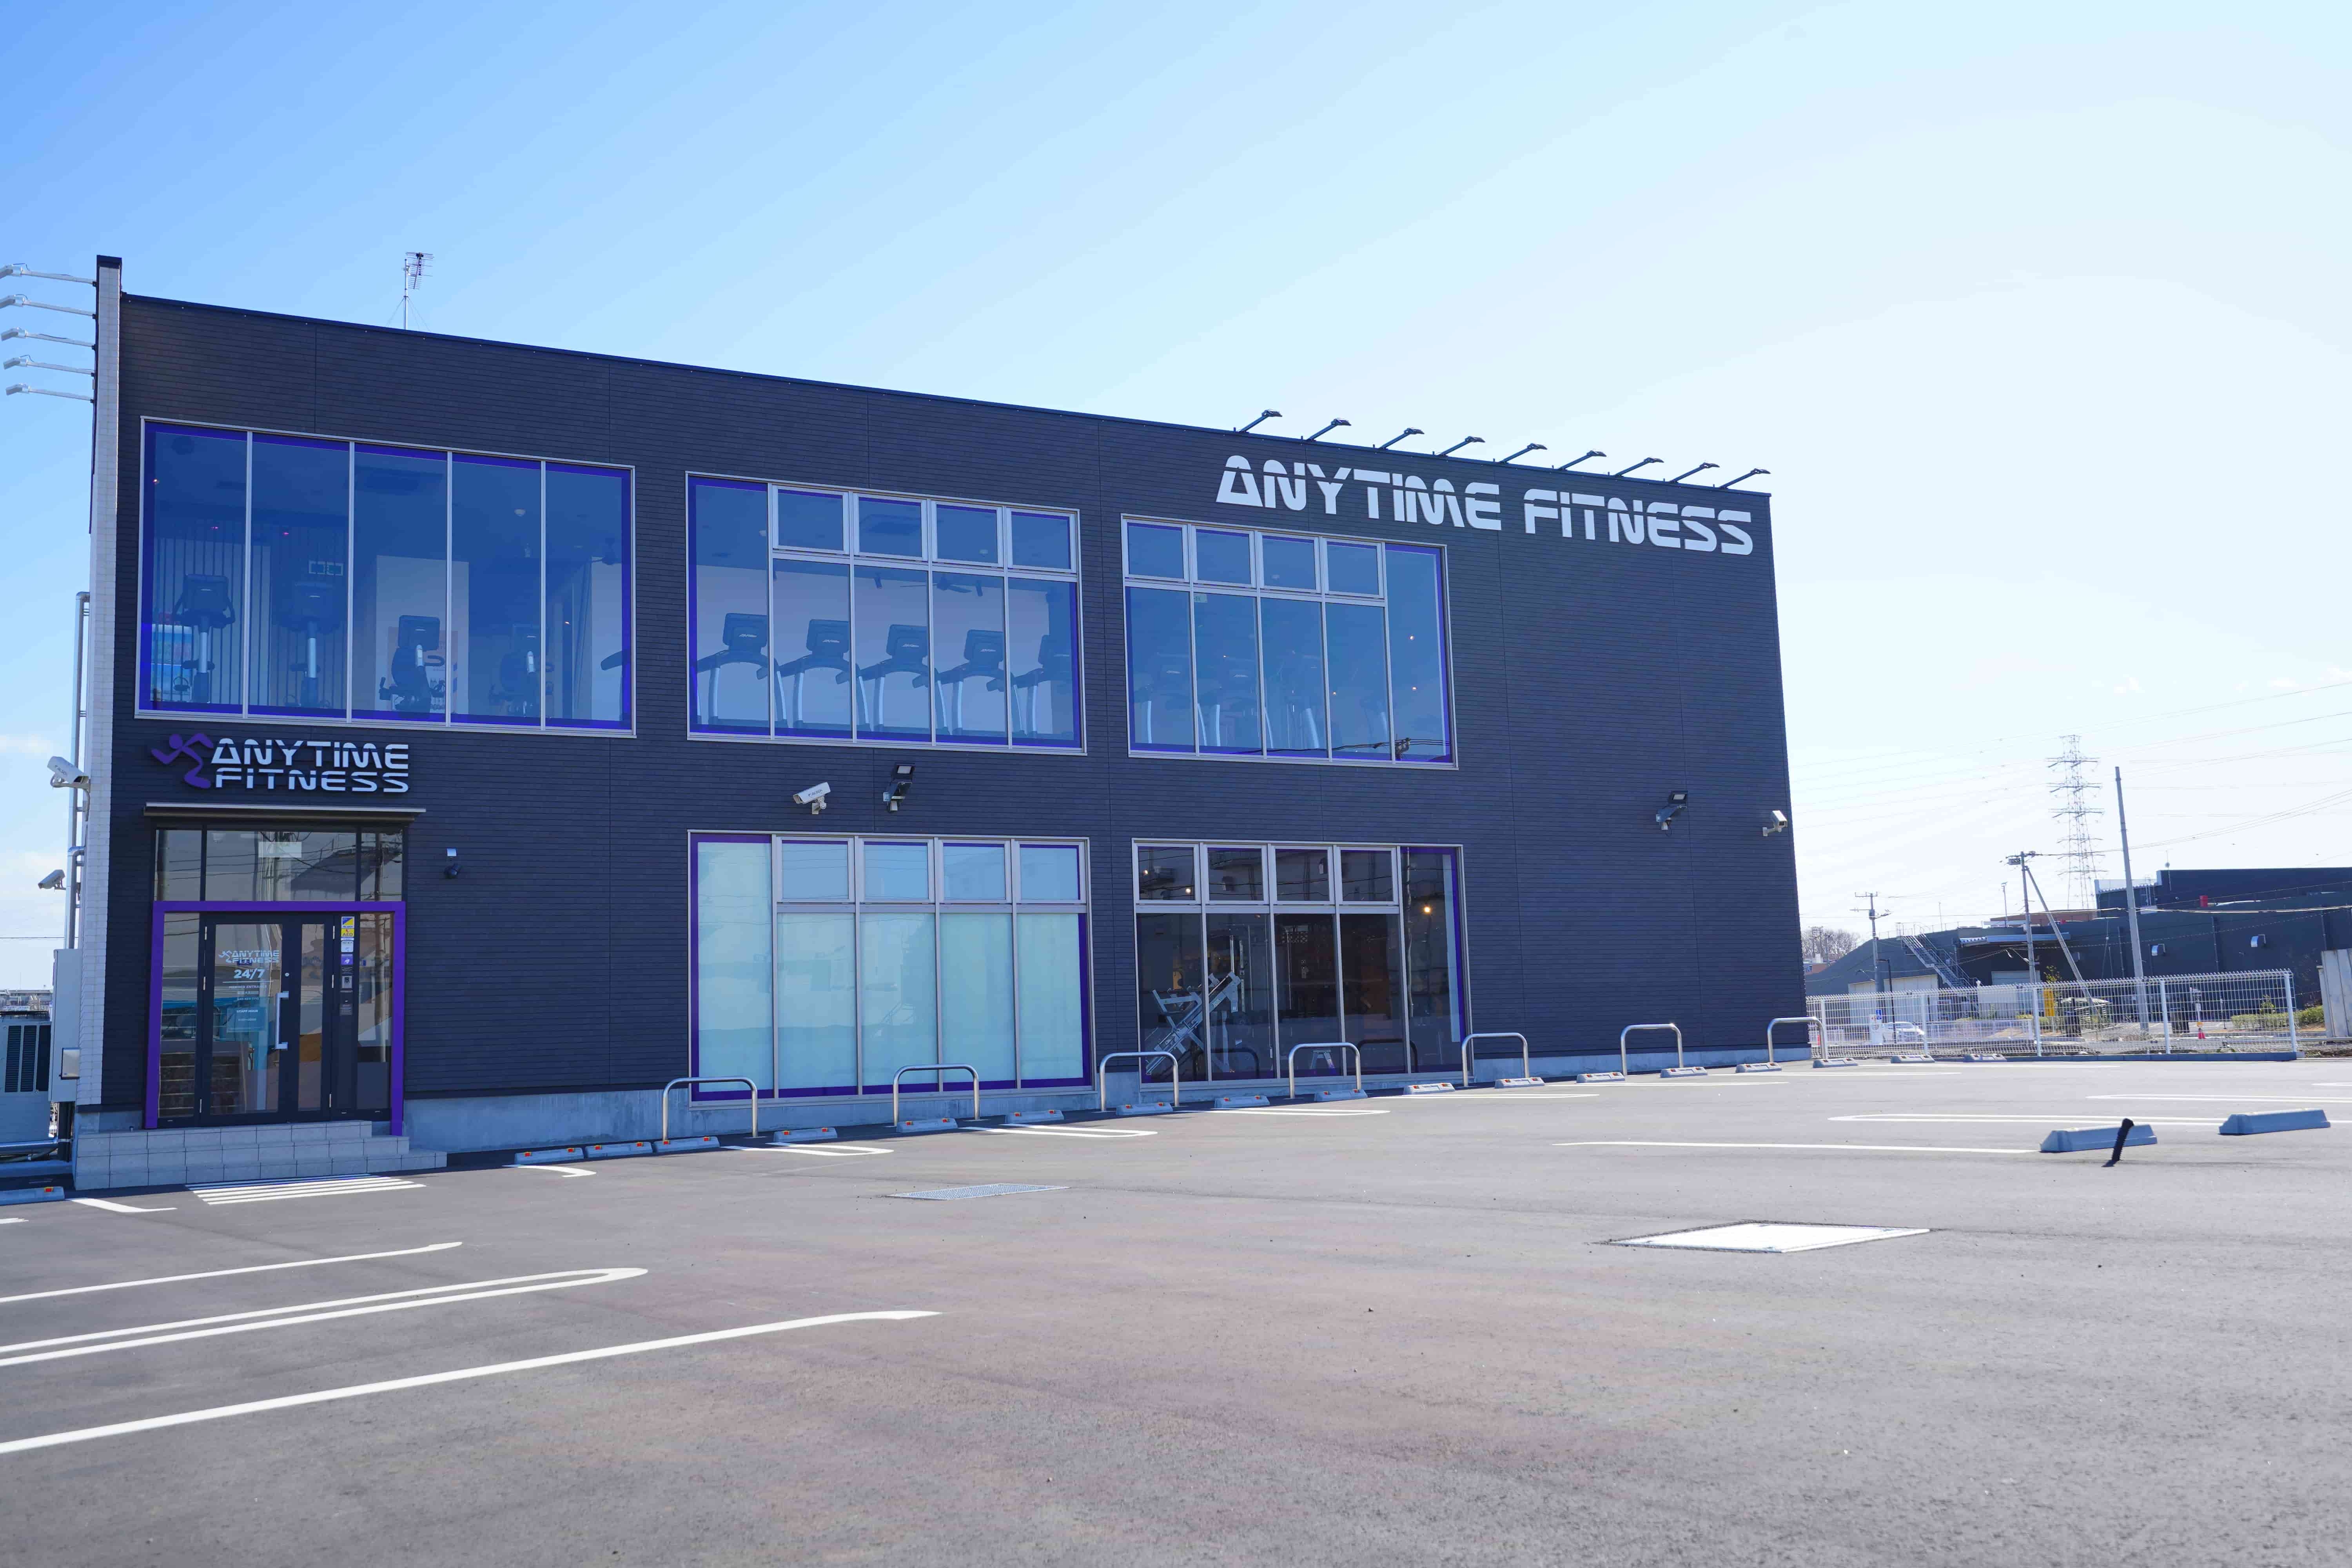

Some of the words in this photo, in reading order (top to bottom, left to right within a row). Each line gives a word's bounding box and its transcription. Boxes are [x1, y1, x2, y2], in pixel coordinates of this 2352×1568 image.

[1216, 455, 1502, 531] ANYTIME
[1523, 488, 1754, 556] FITNESS
[211, 738, 409, 769] ANYTIME
[216, 767, 409, 793] FITNESS
